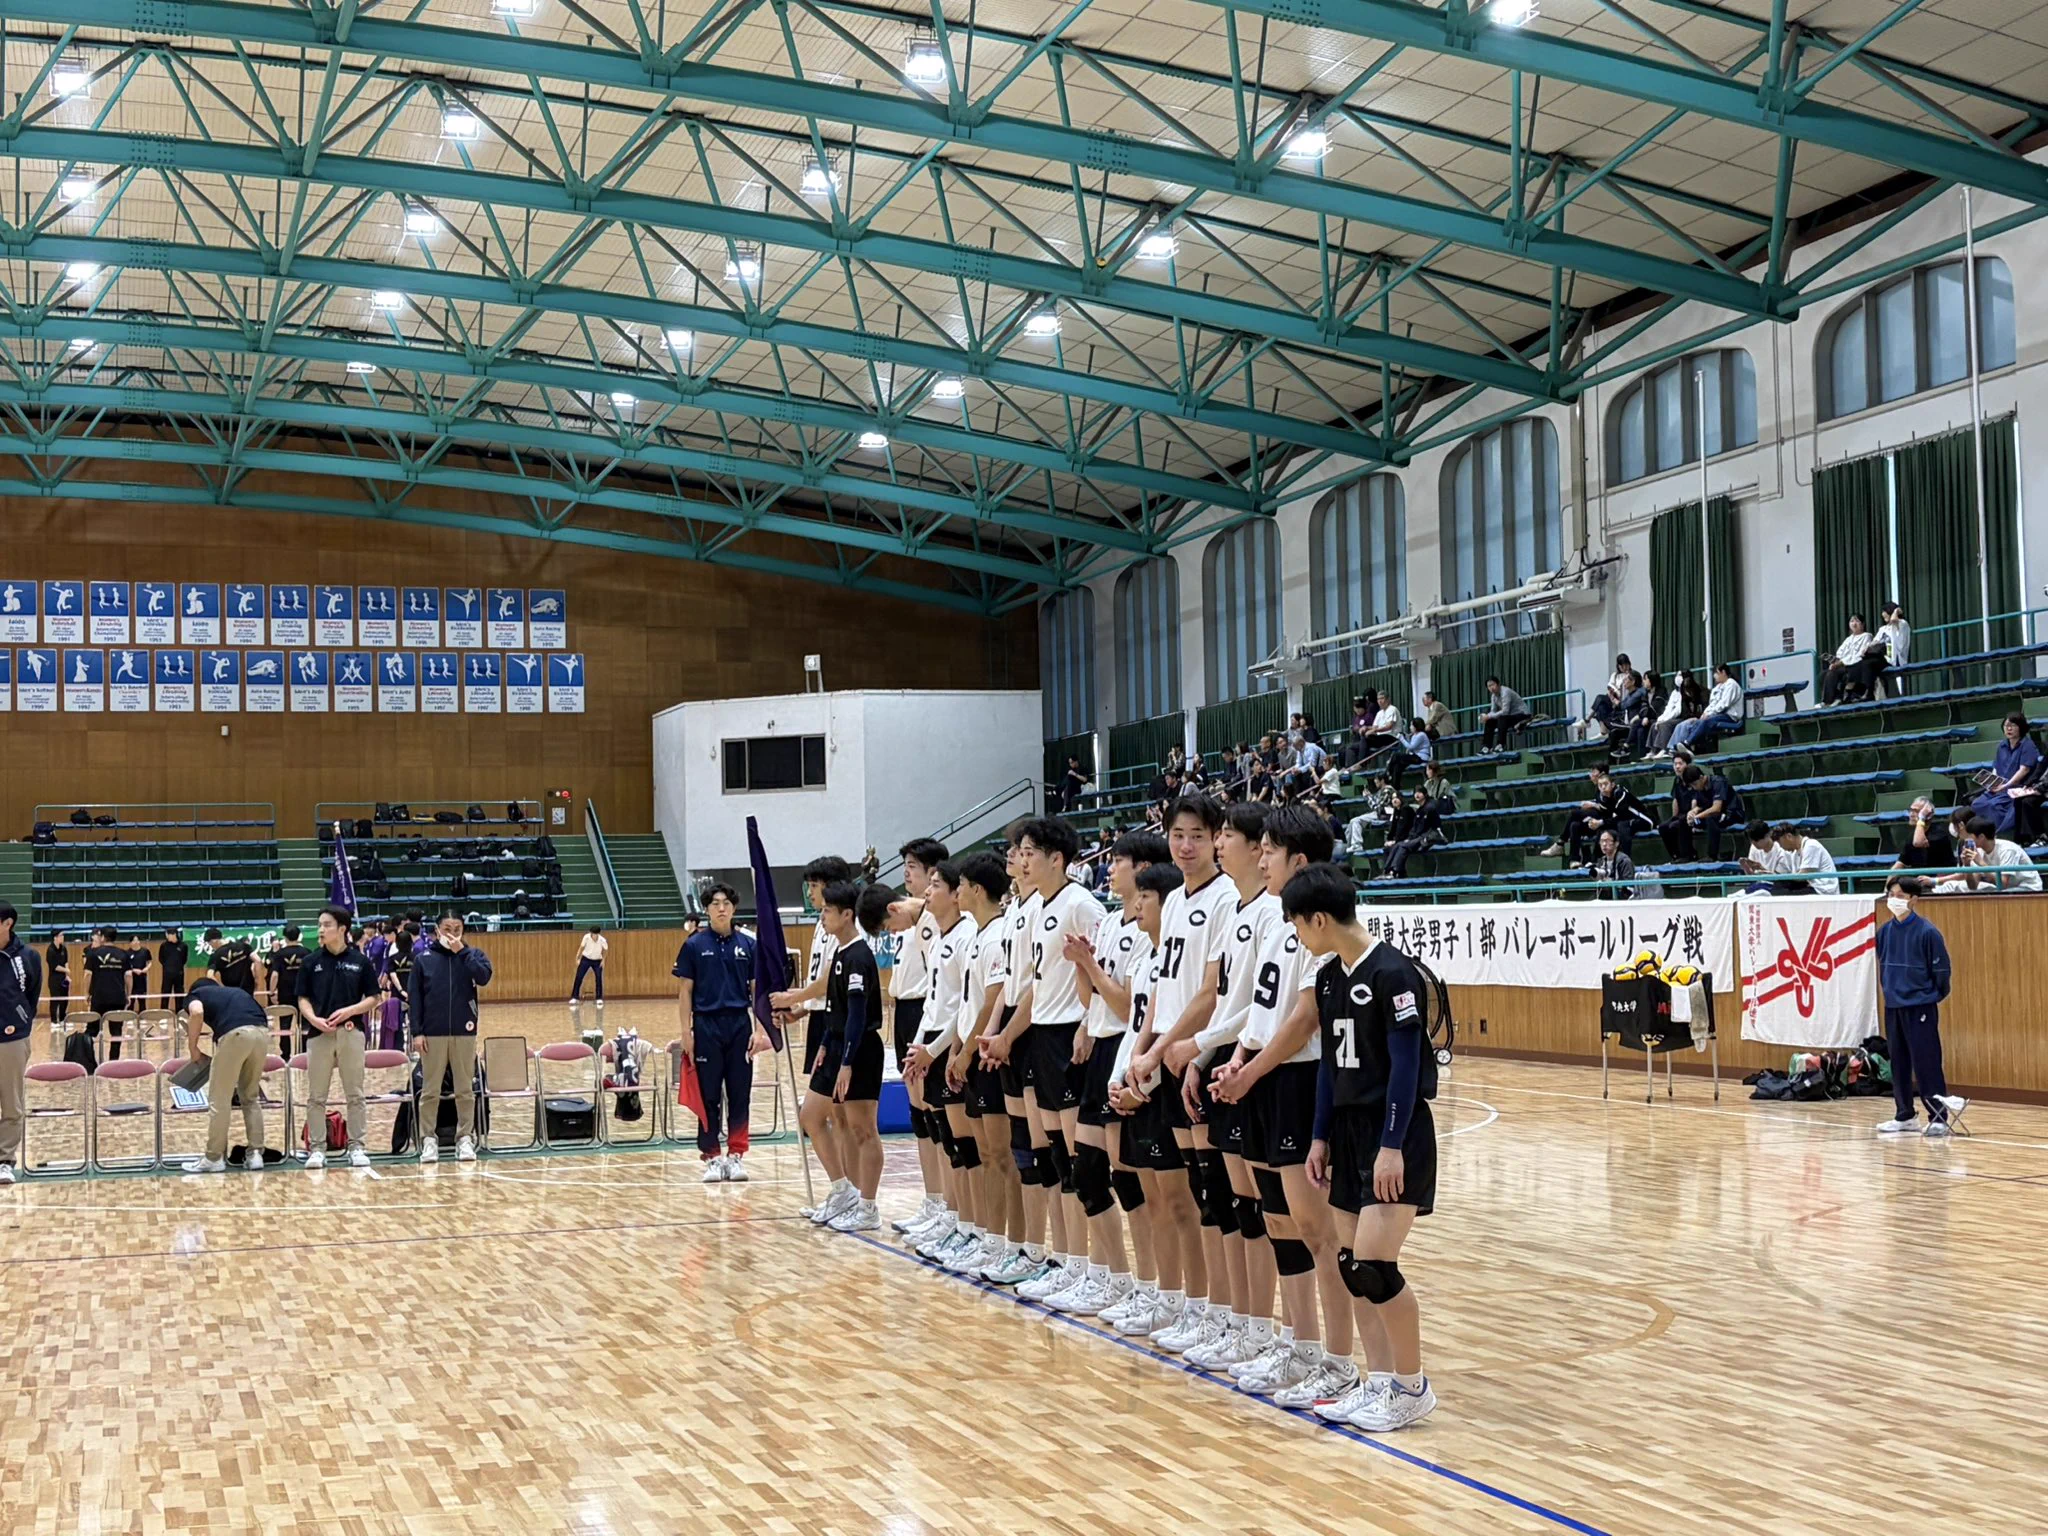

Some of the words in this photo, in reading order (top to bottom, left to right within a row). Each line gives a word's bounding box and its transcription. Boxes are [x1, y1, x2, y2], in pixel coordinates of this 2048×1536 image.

[1159, 936, 1186, 980] 17
[1253, 960, 1282, 1011] 9
[1332, 1017, 1361, 1069] 21
